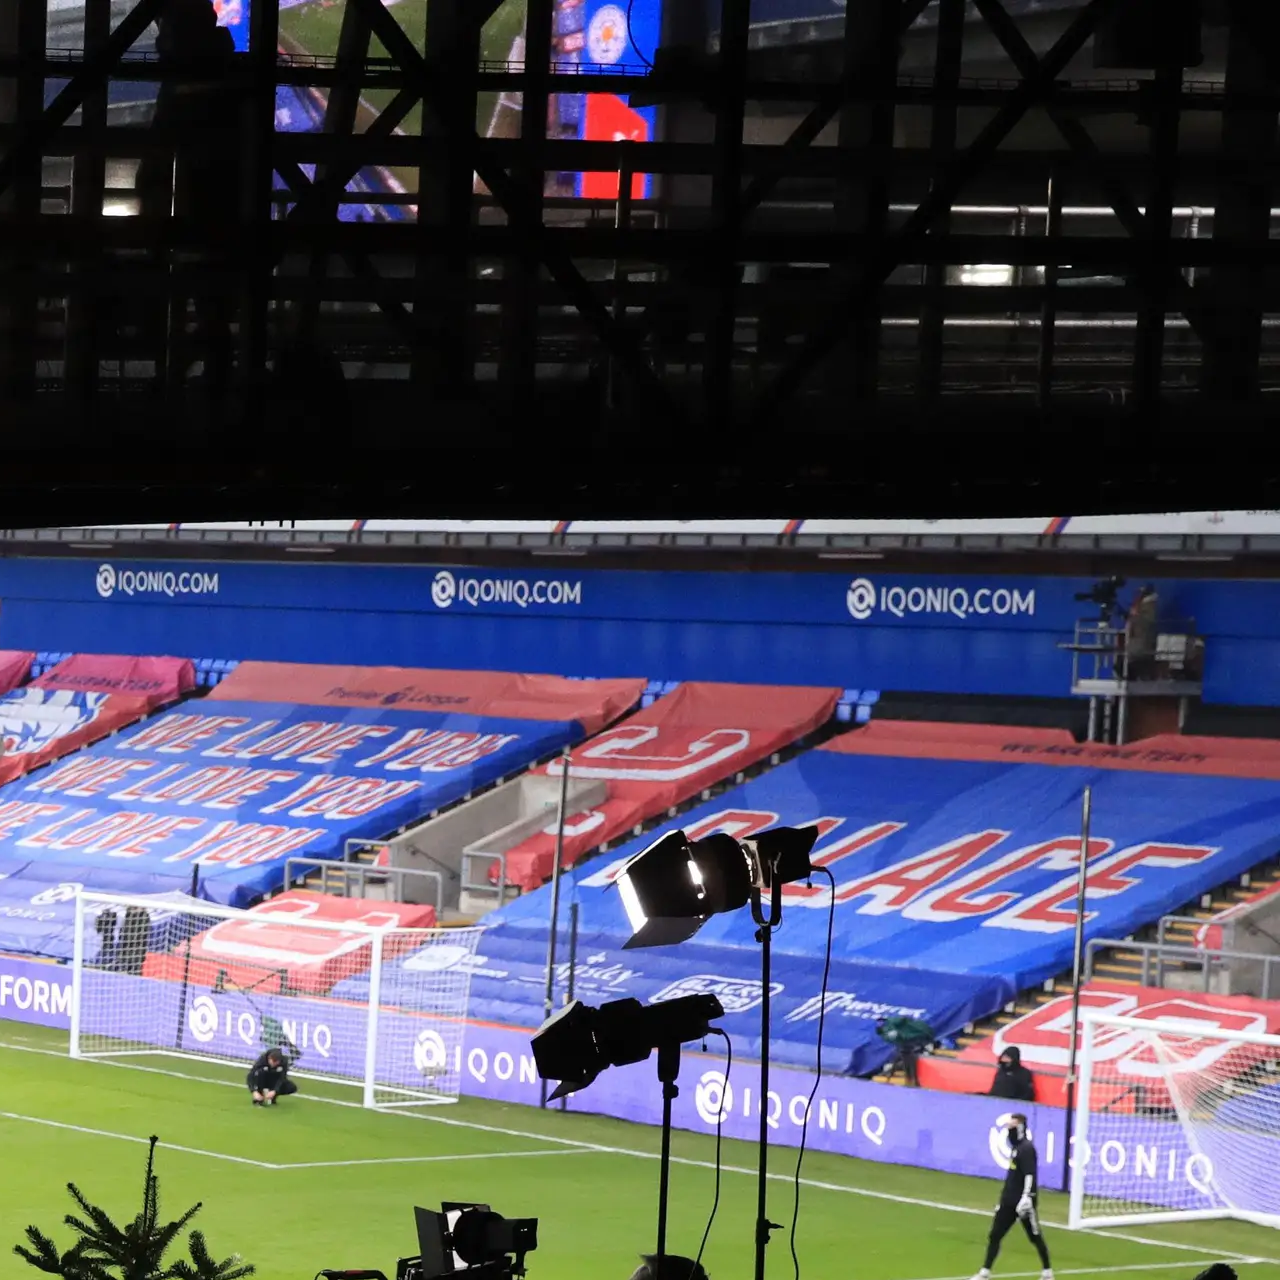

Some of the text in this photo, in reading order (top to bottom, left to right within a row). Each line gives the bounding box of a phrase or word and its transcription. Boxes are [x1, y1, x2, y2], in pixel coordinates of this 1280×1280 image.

[118, 571, 219, 597] IQONIQ.COM
[458, 579, 582, 607] IQONIQ.COM
[880, 587, 1036, 619] IQONIQ.COM
[117, 713, 246, 753] WE
[216, 719, 388, 765] LOVE
[25, 755, 151, 797] WE
[108, 760, 301, 810] LOVE
[16, 805, 205, 857] LOVE
[161, 819, 327, 868] YOU
[577, 809, 1220, 933] PLACE
[226, 1009, 332, 1058] IQNIQ
[455, 1046, 540, 1084] IQON
[743, 1088, 887, 1146] IQONIQ
